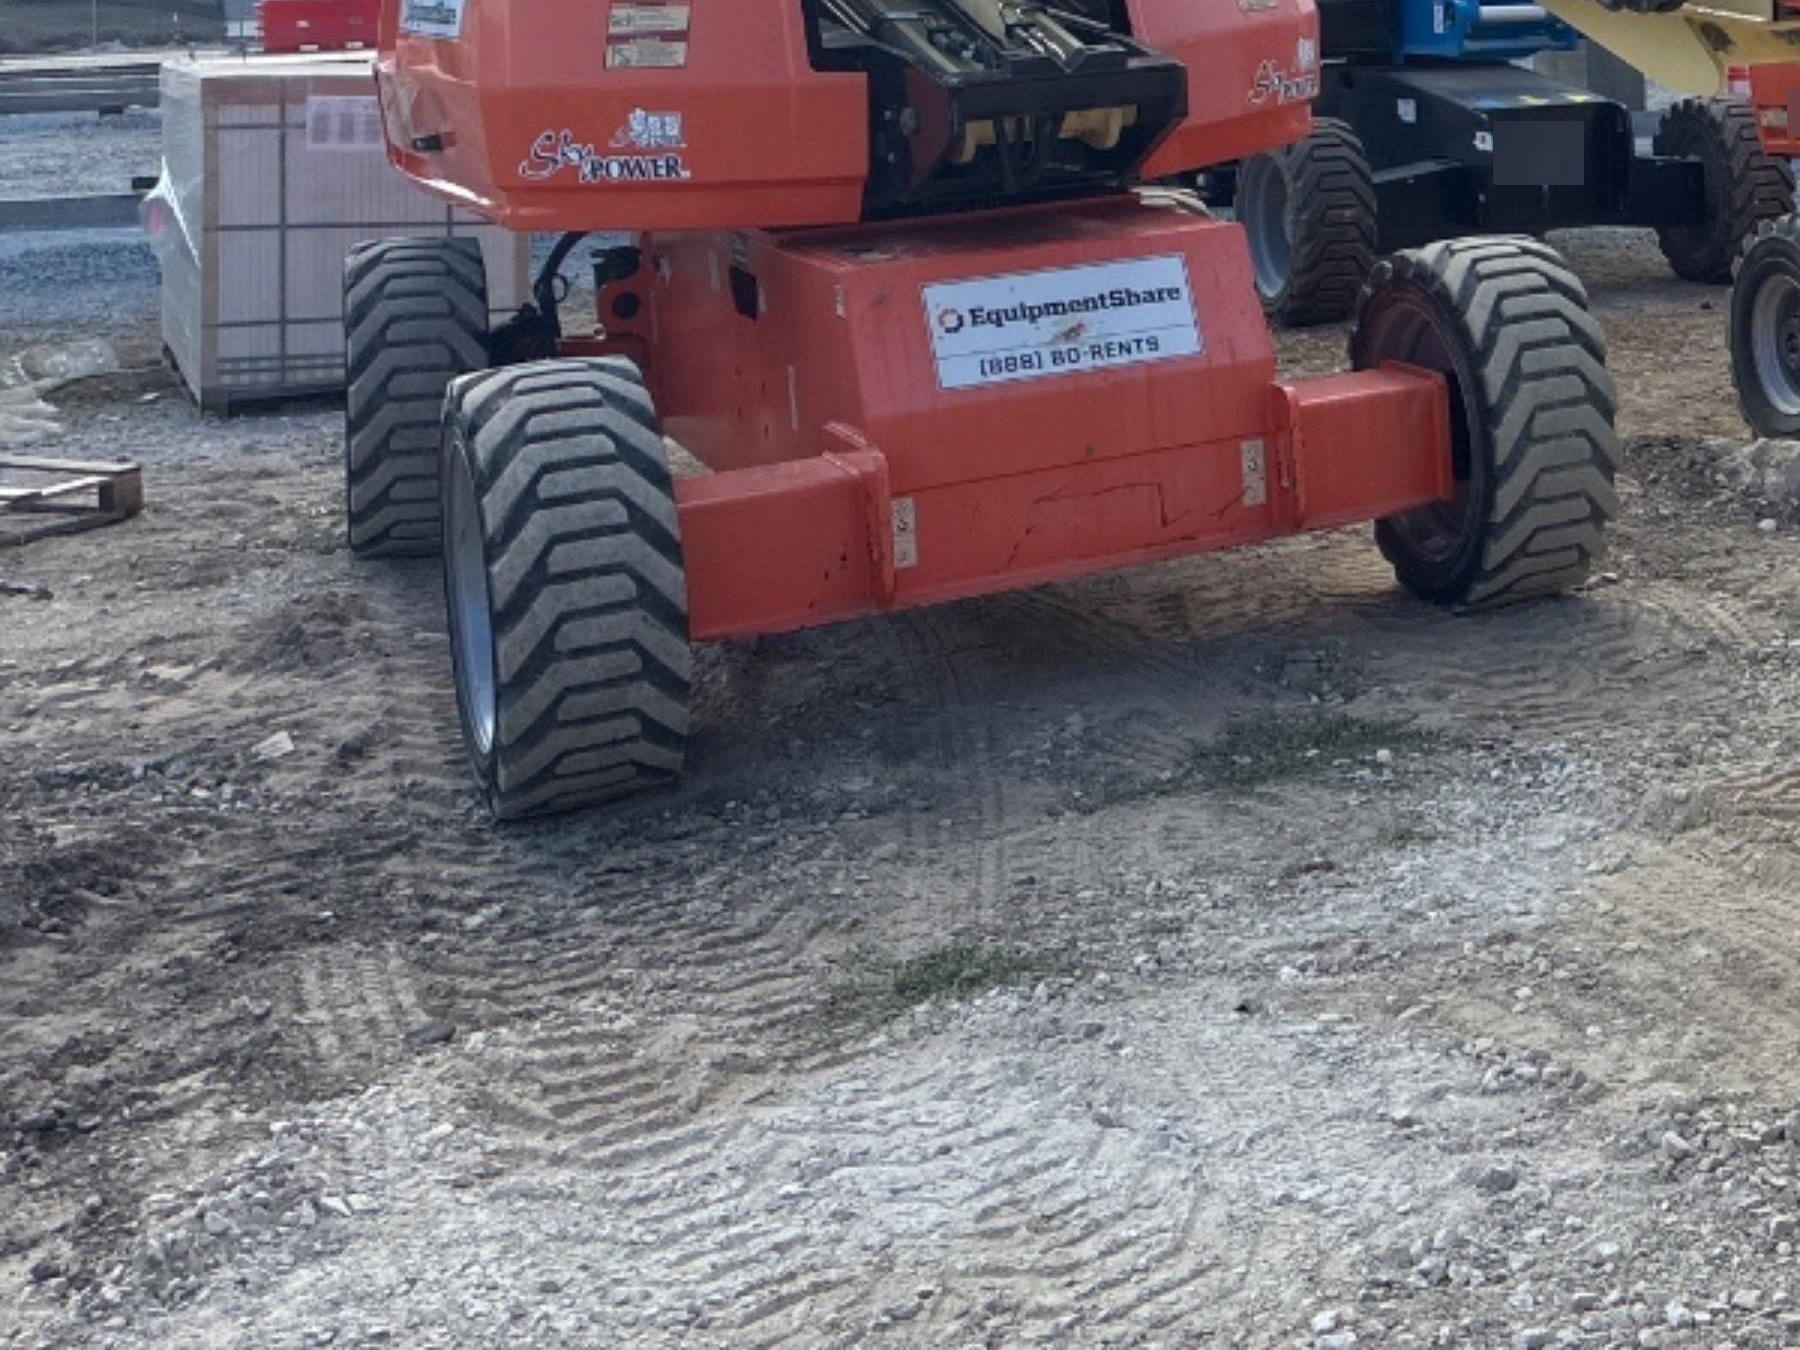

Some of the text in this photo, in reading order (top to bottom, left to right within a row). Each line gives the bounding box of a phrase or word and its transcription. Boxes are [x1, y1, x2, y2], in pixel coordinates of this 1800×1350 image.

[519, 129, 683, 183] Sky POWER
[967, 286, 1182, 328] EquipmentShare
[979, 351, 1043, 378] (888)
